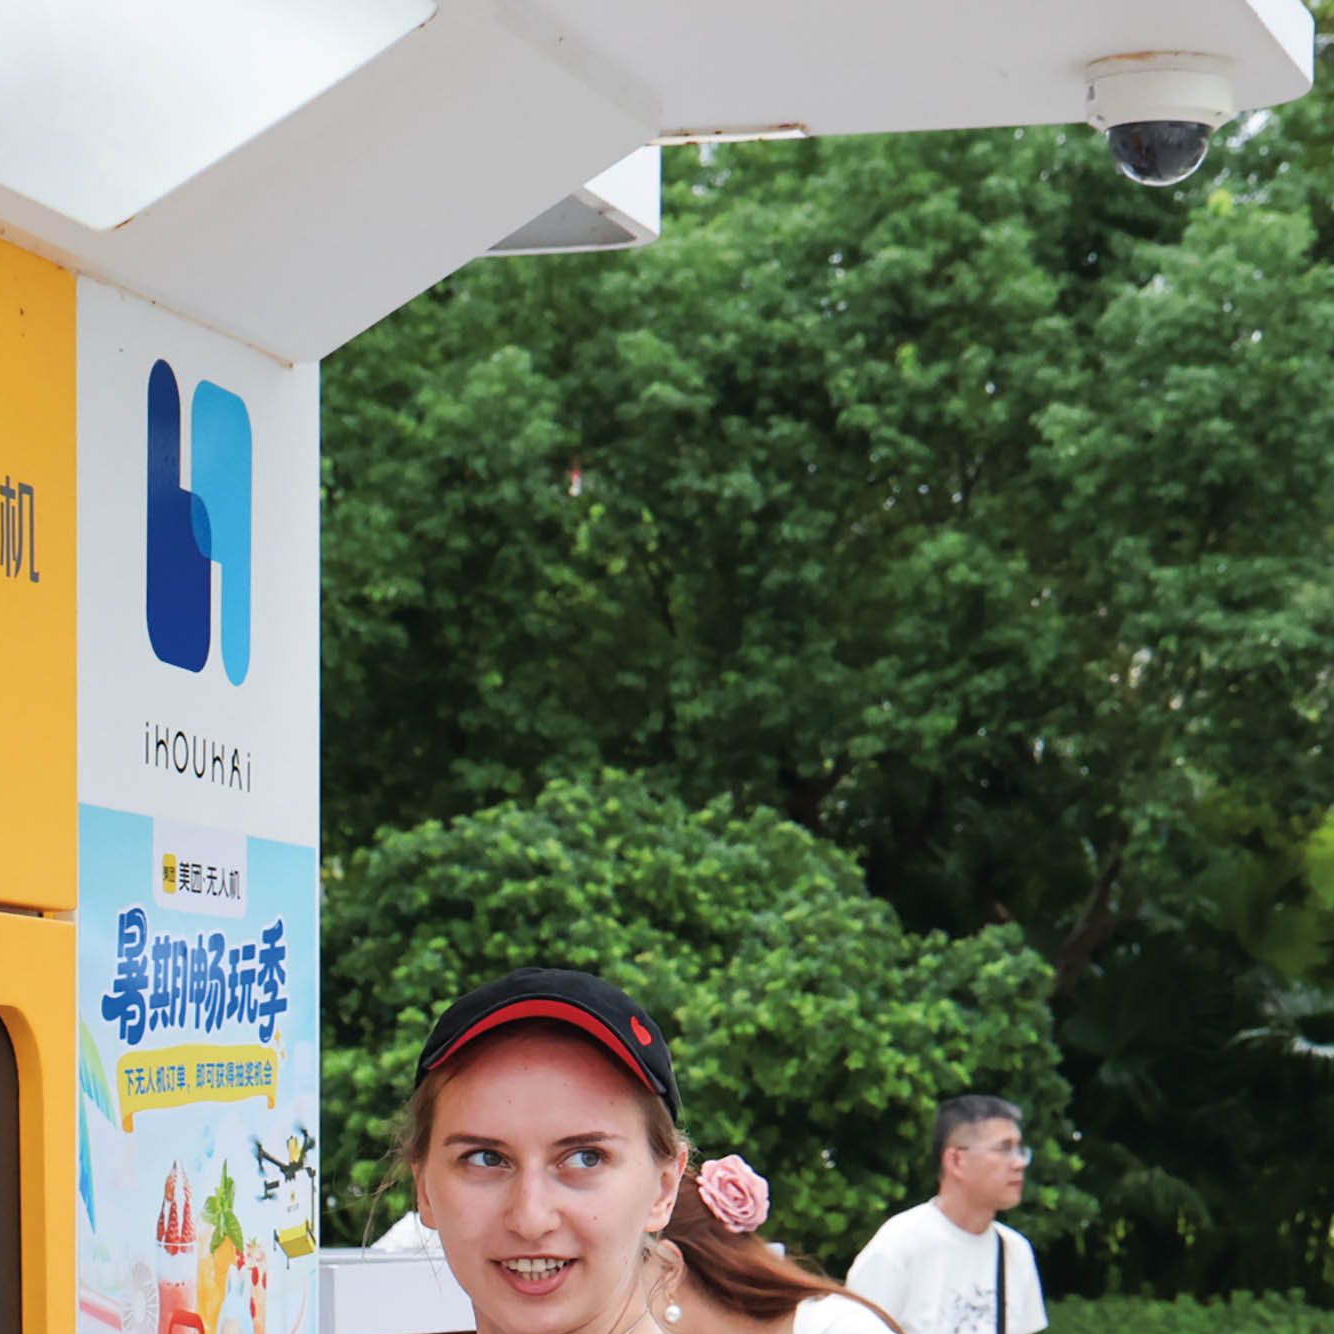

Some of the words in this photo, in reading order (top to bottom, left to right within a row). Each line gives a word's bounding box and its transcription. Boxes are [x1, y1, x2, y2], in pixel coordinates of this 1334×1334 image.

[101, 908, 288, 1045] 暑期畅玩季
